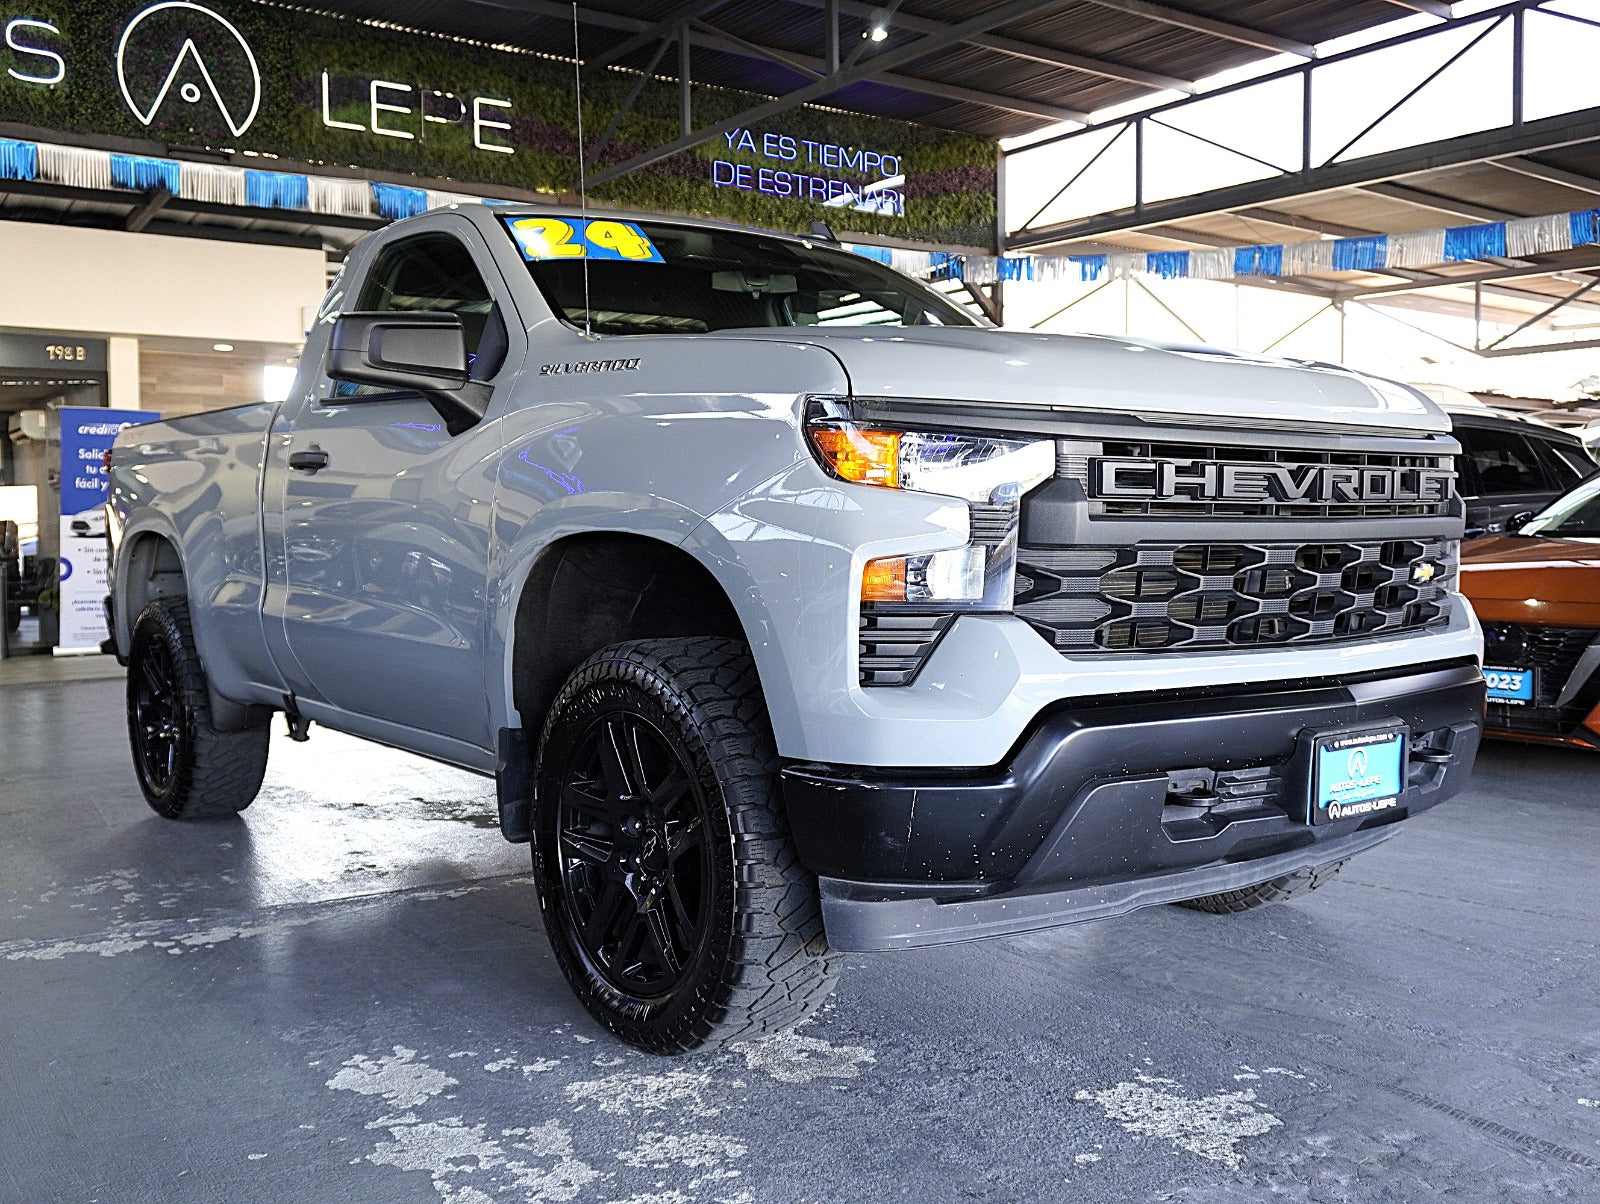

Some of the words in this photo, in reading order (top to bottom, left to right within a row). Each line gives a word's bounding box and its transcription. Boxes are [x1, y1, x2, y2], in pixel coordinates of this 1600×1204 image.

[5, 18, 66, 84] S
[321, 70, 515, 154] LEPE
[724, 127, 757, 153] YA
[763, 132, 797, 161] ES
[801, 139, 900, 178] TIEMPO
[713, 160, 753, 191] DE
[758, 167, 899, 213] ESTRENAR
[512, 218, 654, 260] 24
[539, 357, 642, 377] SILVERADO
[85, 464, 97, 475] tu
[1101, 460, 1458, 501] CHEVROLET
[1485, 672, 1523, 691] 023
[1341, 797, 1397, 817] AUTOS-LEPE
